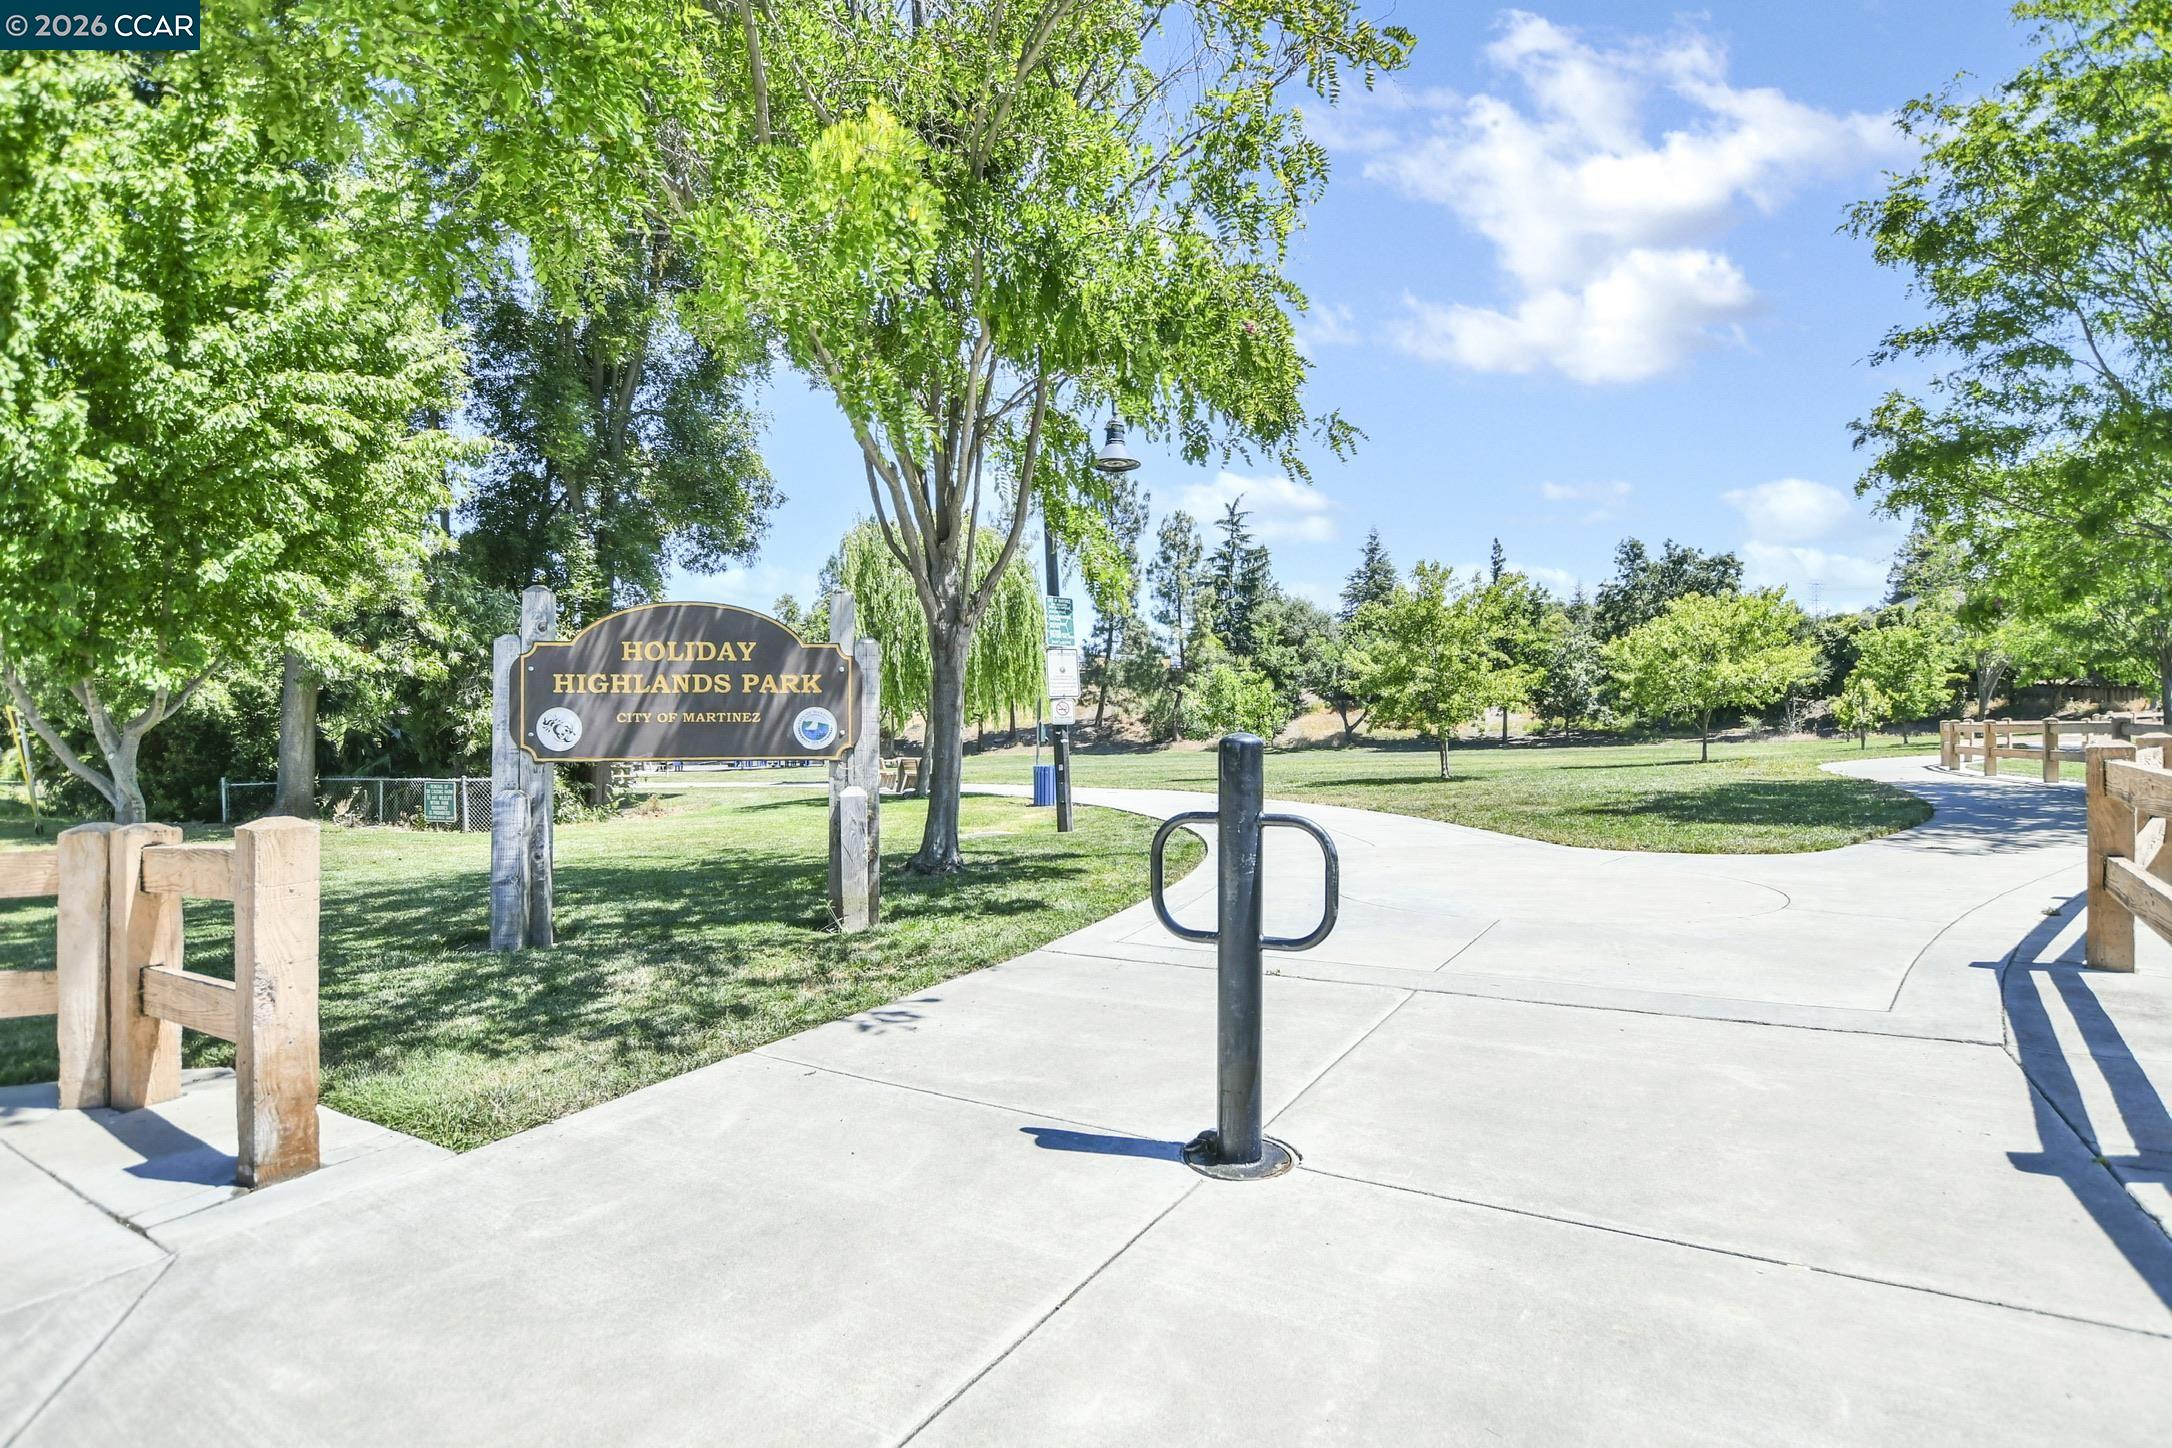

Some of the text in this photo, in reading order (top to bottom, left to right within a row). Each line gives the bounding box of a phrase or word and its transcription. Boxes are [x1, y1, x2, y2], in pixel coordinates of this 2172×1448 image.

[621, 641, 756, 662] HOLIDAY
[553, 673, 822, 694] HIGHLANDS PARK
[616, 712, 761, 723] CITY OF MARTINEZ
